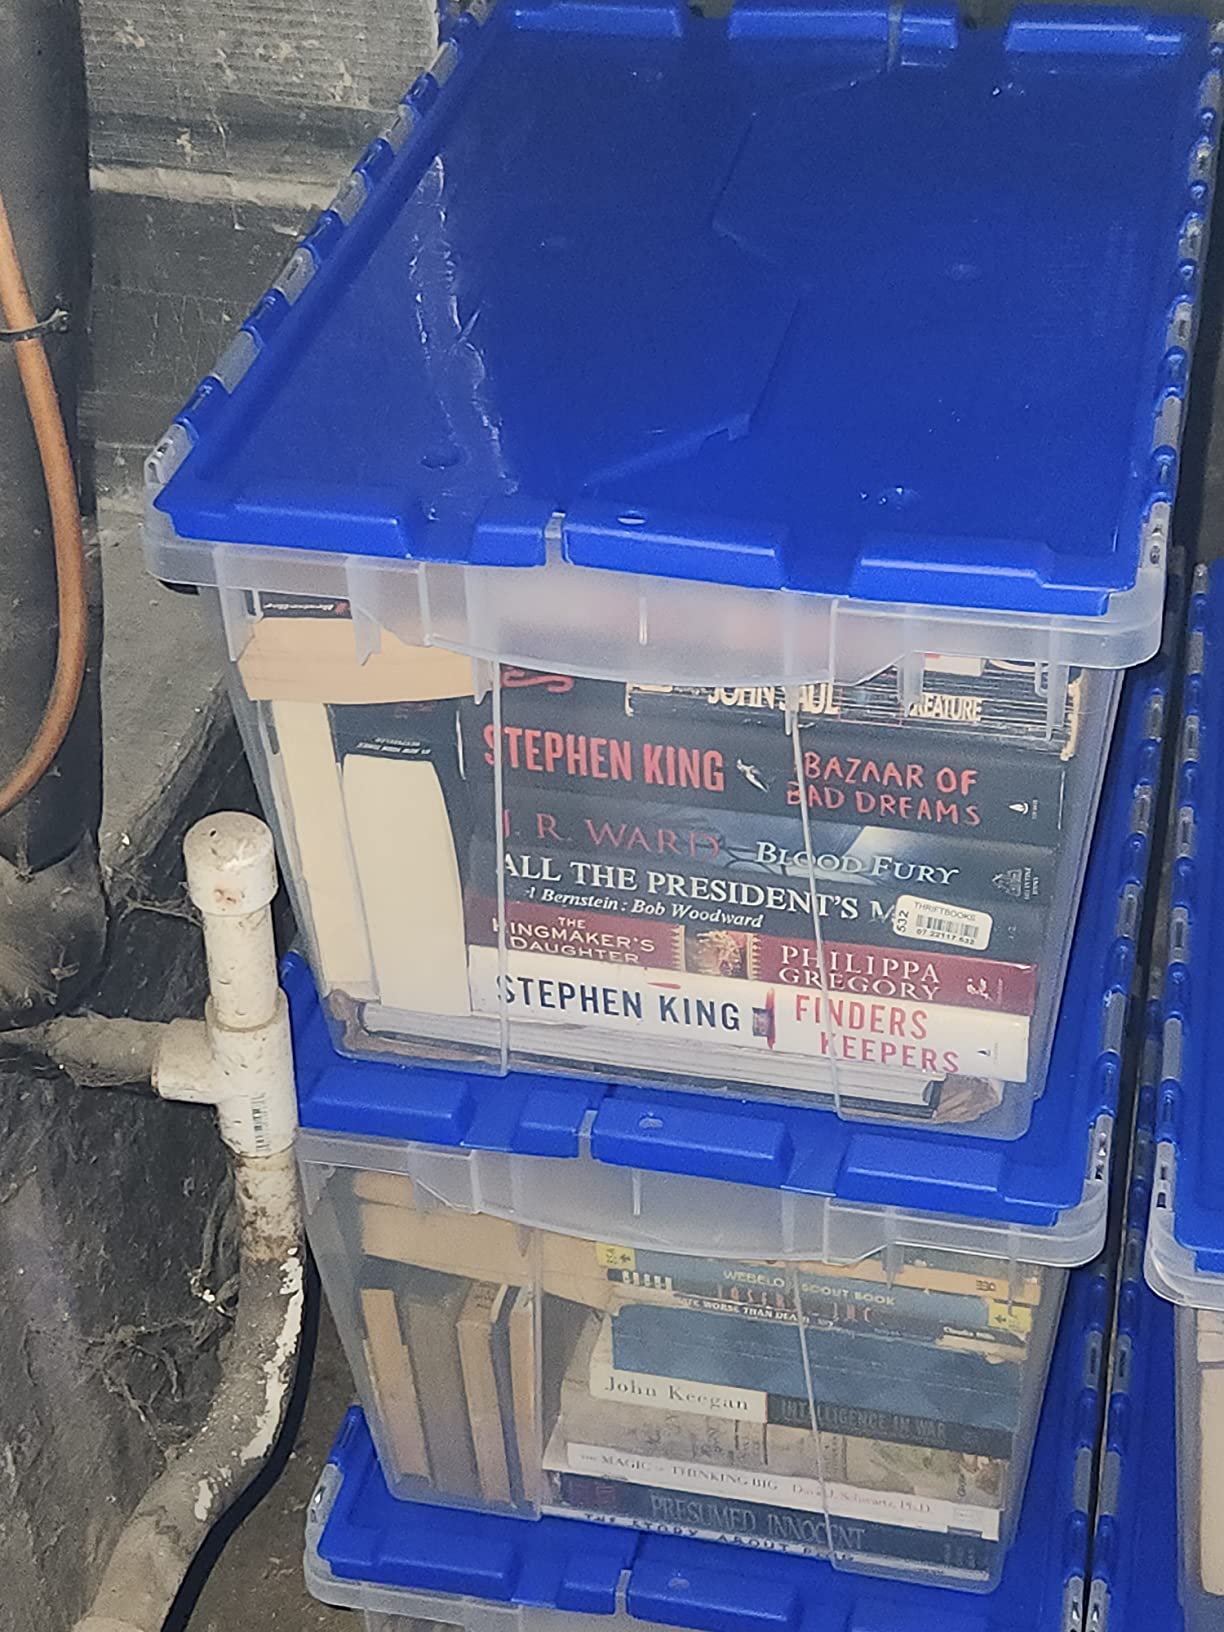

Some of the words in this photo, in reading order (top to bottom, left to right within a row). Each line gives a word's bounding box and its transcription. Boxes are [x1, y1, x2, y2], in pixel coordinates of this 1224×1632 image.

[483, 724, 632, 781] STEPHEN
[643, 743, 725, 792] KING
[804, 751, 924, 789] BAZAAR
[936, 767, 978, 796] OF
[787, 781, 845, 808] BAD
[855, 790, 981, 826] DREAMS
[585, 818, 722, 858] WARD
[505, 853, 562, 882] ALL
[570, 861, 637, 891] THE
[755, 841, 863, 874] BLOOD
[872, 855, 960, 885] FURY
[541, 887, 618, 911] Bernstein
[632, 899, 665, 916] Bob
[672, 903, 764, 928] Woodward
[558, 916, 586, 929] THE
[509, 936, 640, 964] DAUGHTER
[781, 945, 940, 984] PHILIPPA
[495, 973, 642, 1019] STEPHEN
[660, 995, 740, 1031] KING
[779, 967, 941, 1001] GREGORY
[795, 994, 928, 1040] FINDERS
[723, 1269, 790, 1289] WEBELO
[801, 1283, 850, 1297] SCOUT
[854, 1291, 896, 1306] BOOK
[743, 1306, 773, 1319] THAN
[775, 1311, 810, 1325] DEAH
[604, 1376, 657, 1397] John
[669, 1385, 749, 1411] Keegan
[782, 1400, 890, 1431] INTLLIGENCE
[915, 1419, 947, 1440] WAR
[601, 1455, 651, 1472] MAGIC
[672, 1466, 748, 1486] THINKING
[752, 1478, 778, 1490] BIG
[651, 1494, 756, 1533] PRESUMED
